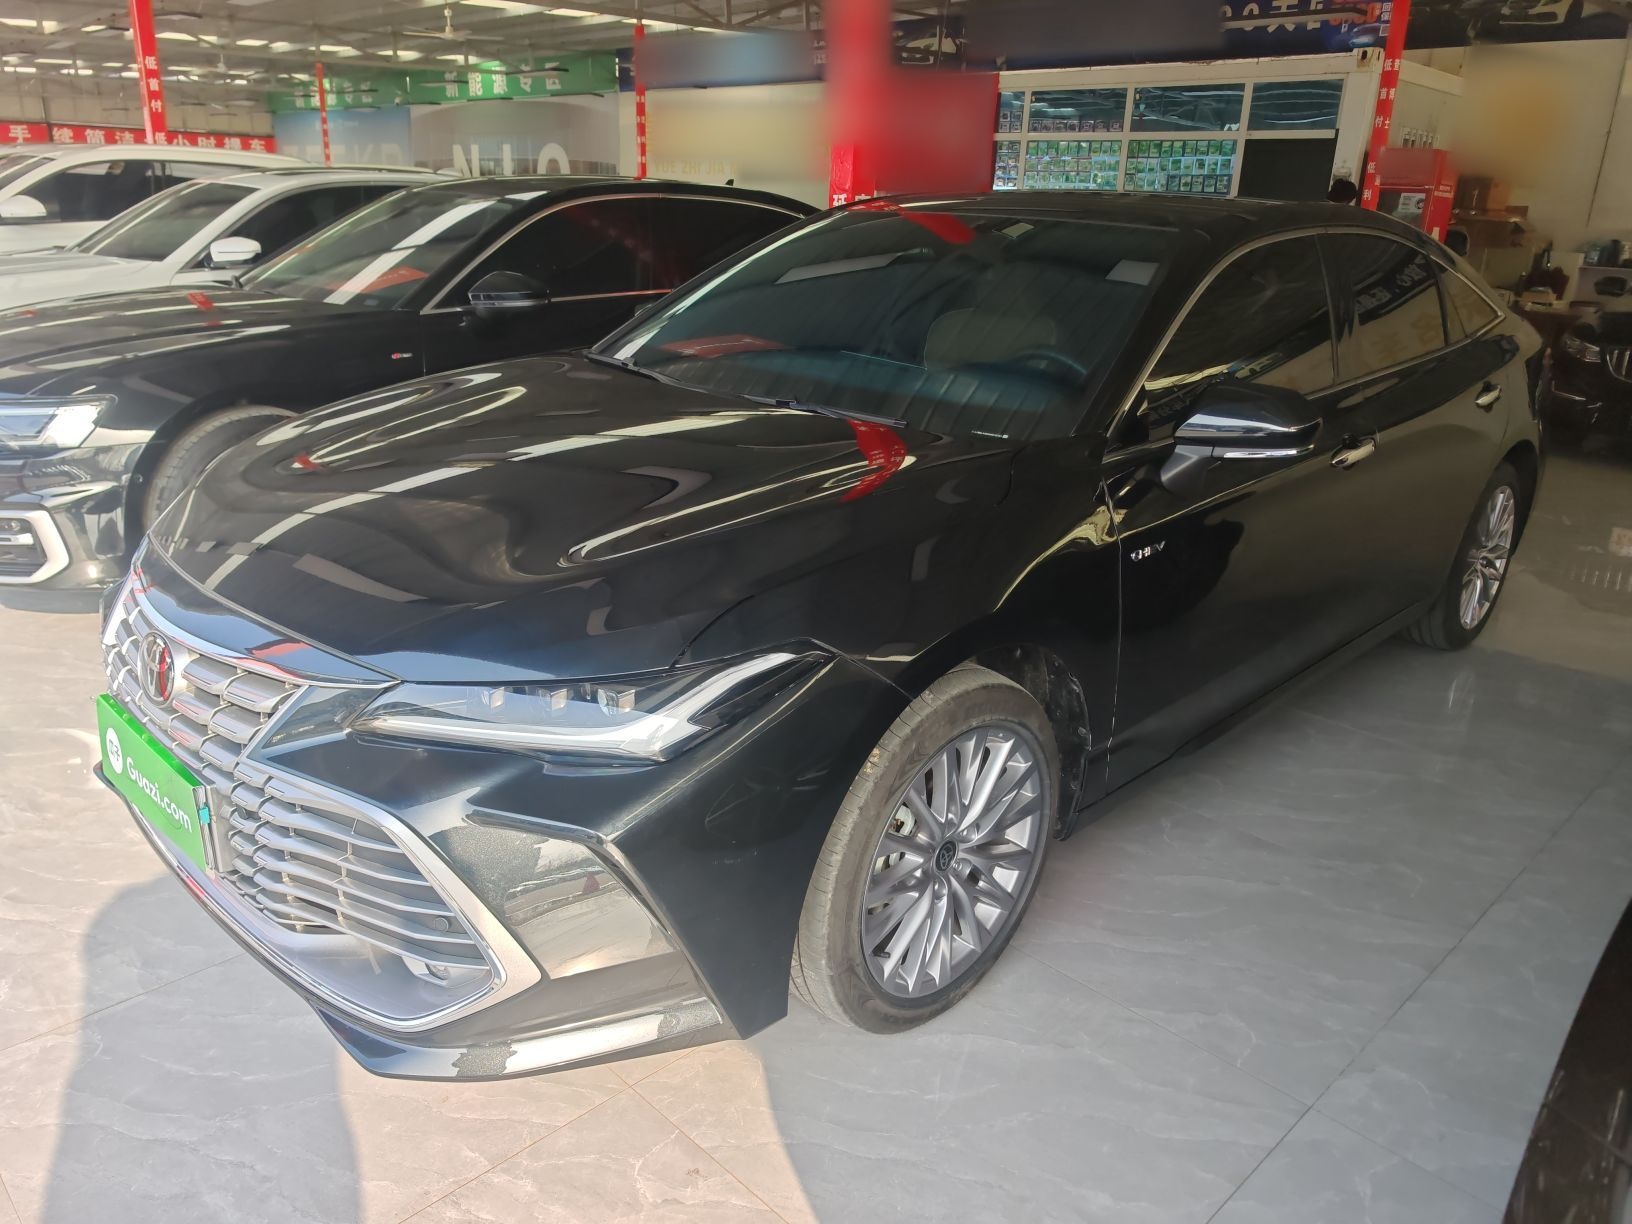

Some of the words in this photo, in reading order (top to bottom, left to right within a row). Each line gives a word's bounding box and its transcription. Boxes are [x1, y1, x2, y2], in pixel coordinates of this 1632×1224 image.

[144, 55, 163, 113] 低首付
[126, 756, 193, 833] Guazi.com
